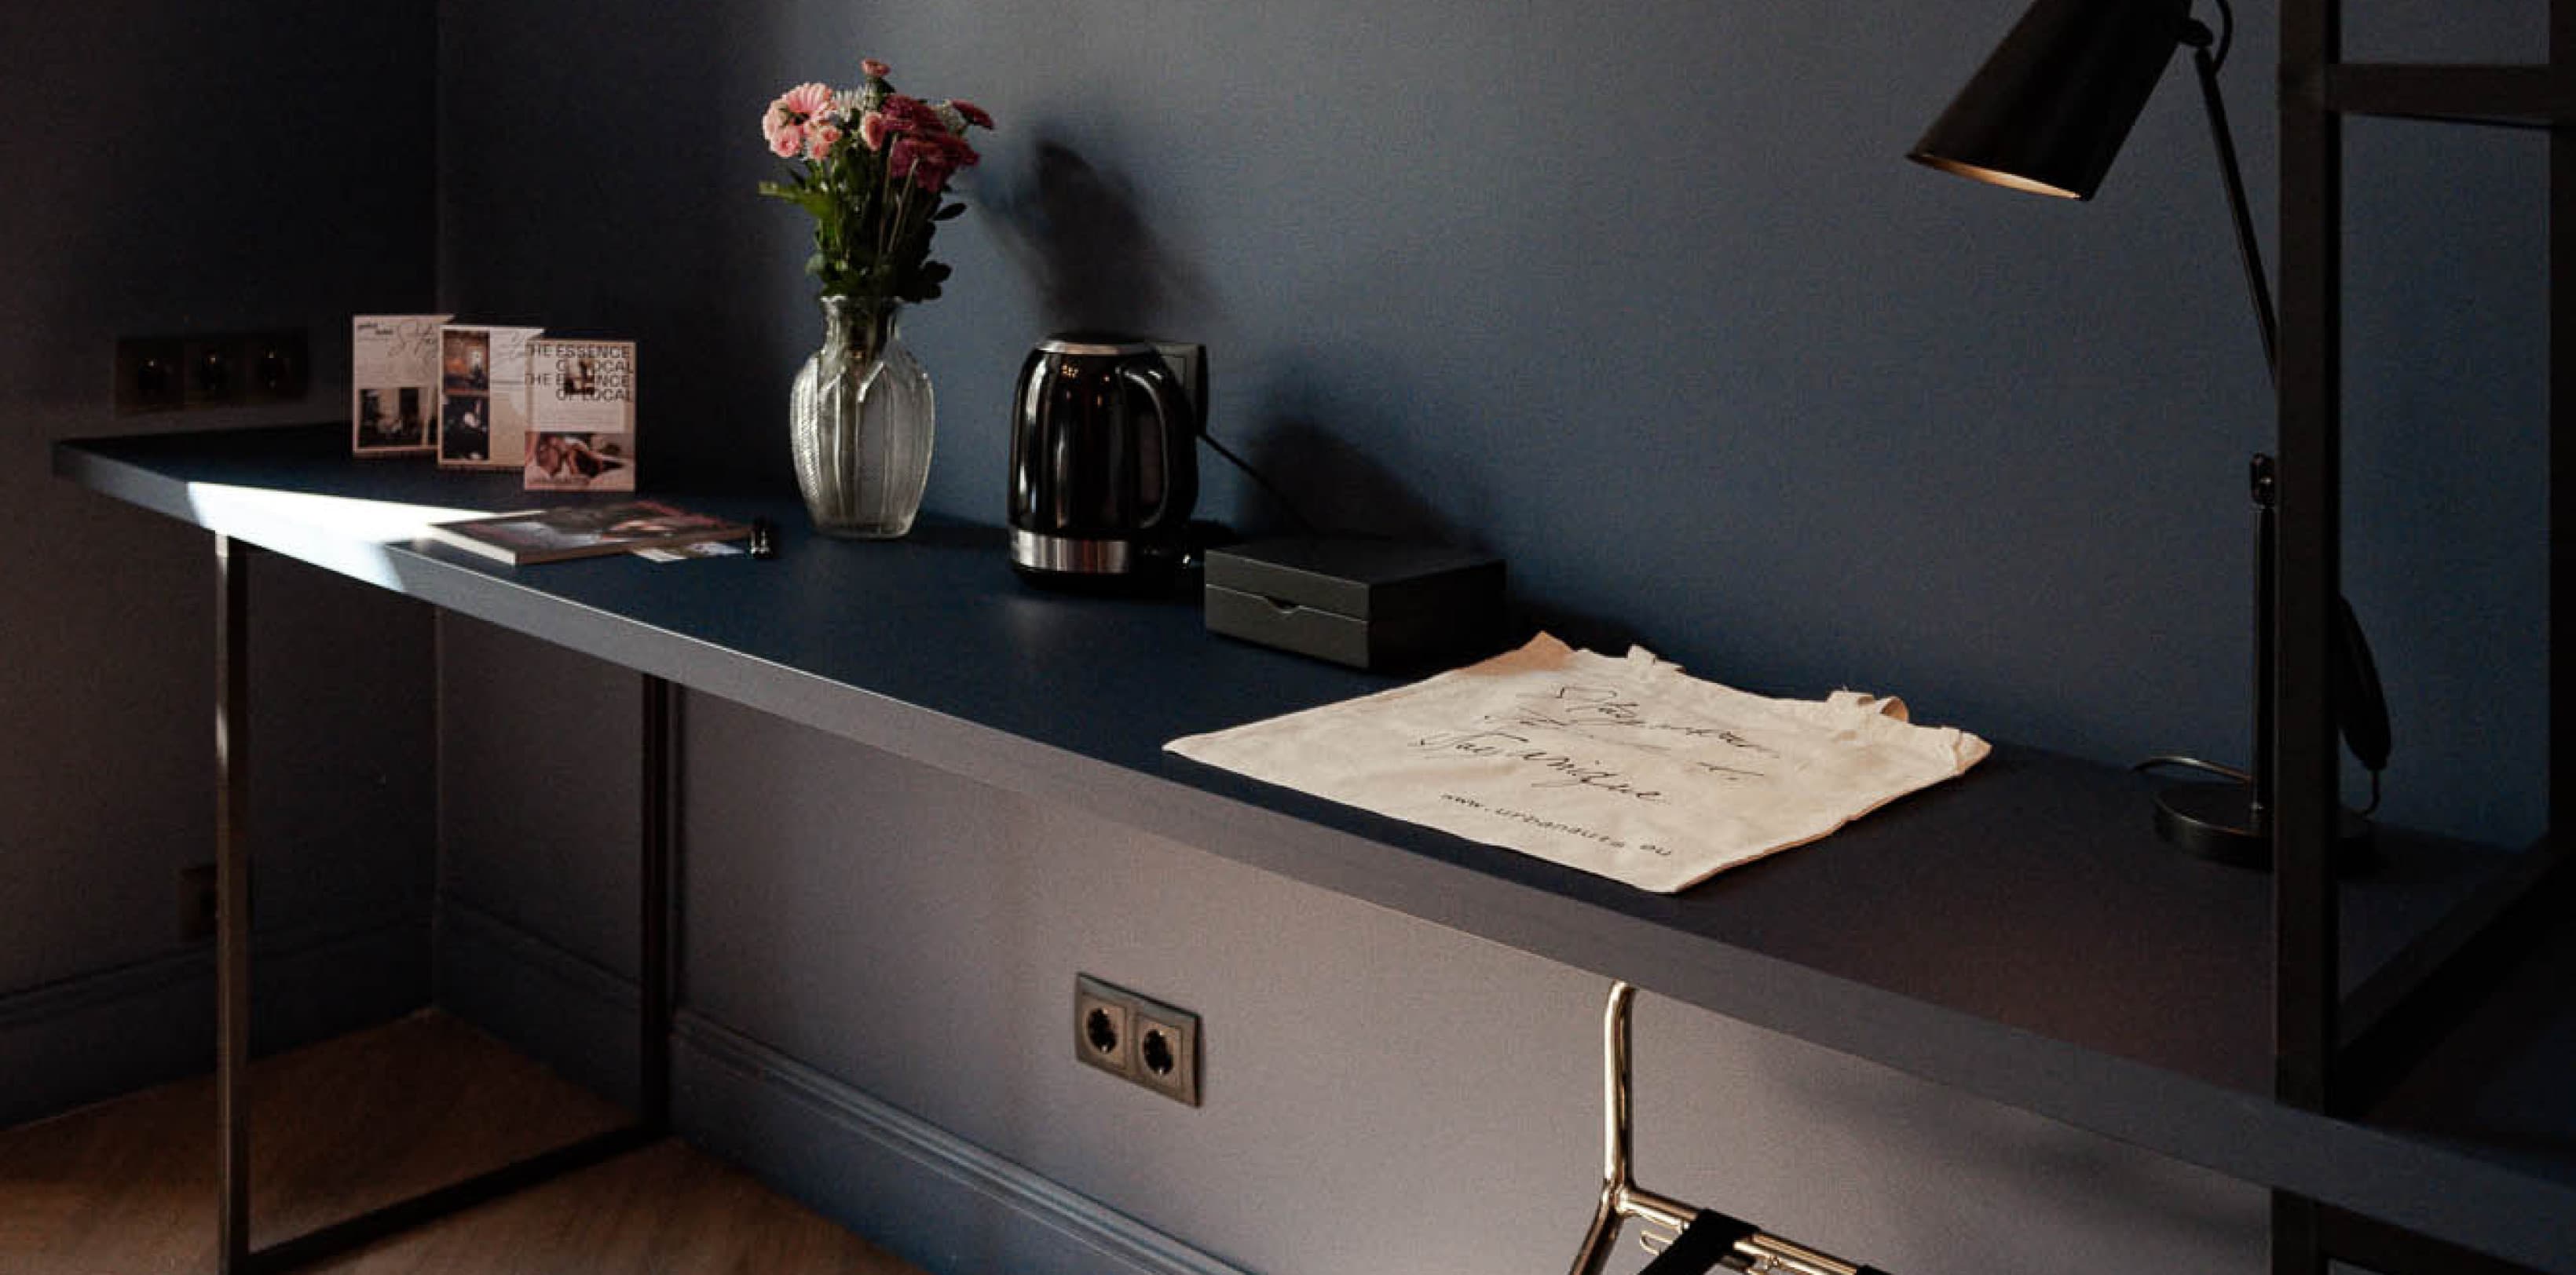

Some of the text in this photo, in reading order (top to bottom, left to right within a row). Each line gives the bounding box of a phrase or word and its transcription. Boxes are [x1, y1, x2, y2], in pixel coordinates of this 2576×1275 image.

[525, 345, 630, 360] THE ESSENCE
[584, 360, 633, 373] OCAL
[525, 374, 630, 387] THE ENCE
[1440, 793, 1672, 856] www.urbanautseu
